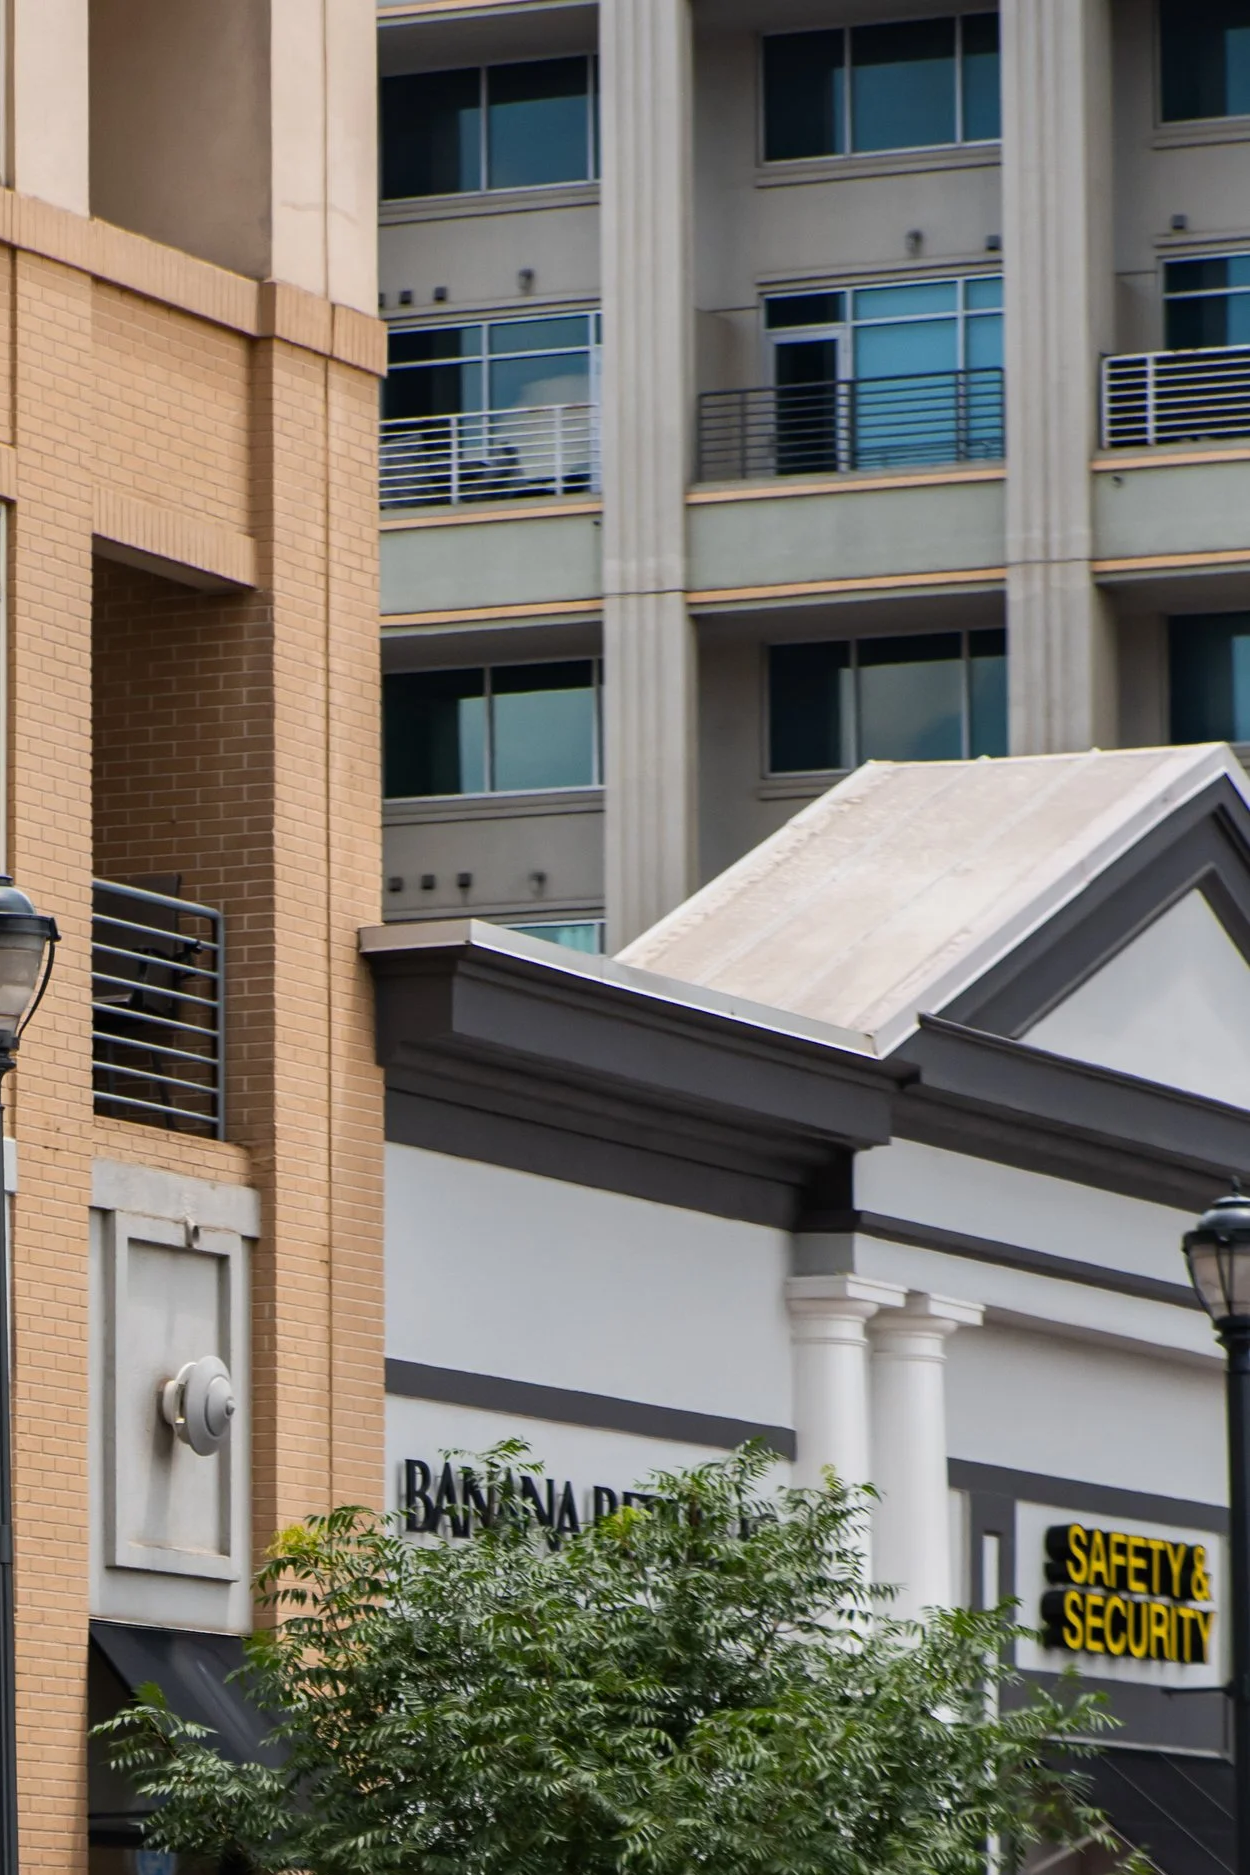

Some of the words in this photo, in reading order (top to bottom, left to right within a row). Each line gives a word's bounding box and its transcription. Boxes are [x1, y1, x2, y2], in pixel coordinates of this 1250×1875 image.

[1065, 1523, 1187, 1598] SAFETY
[1190, 1544, 1212, 1602] &
[1061, 1589, 1215, 1664] SECURITY
